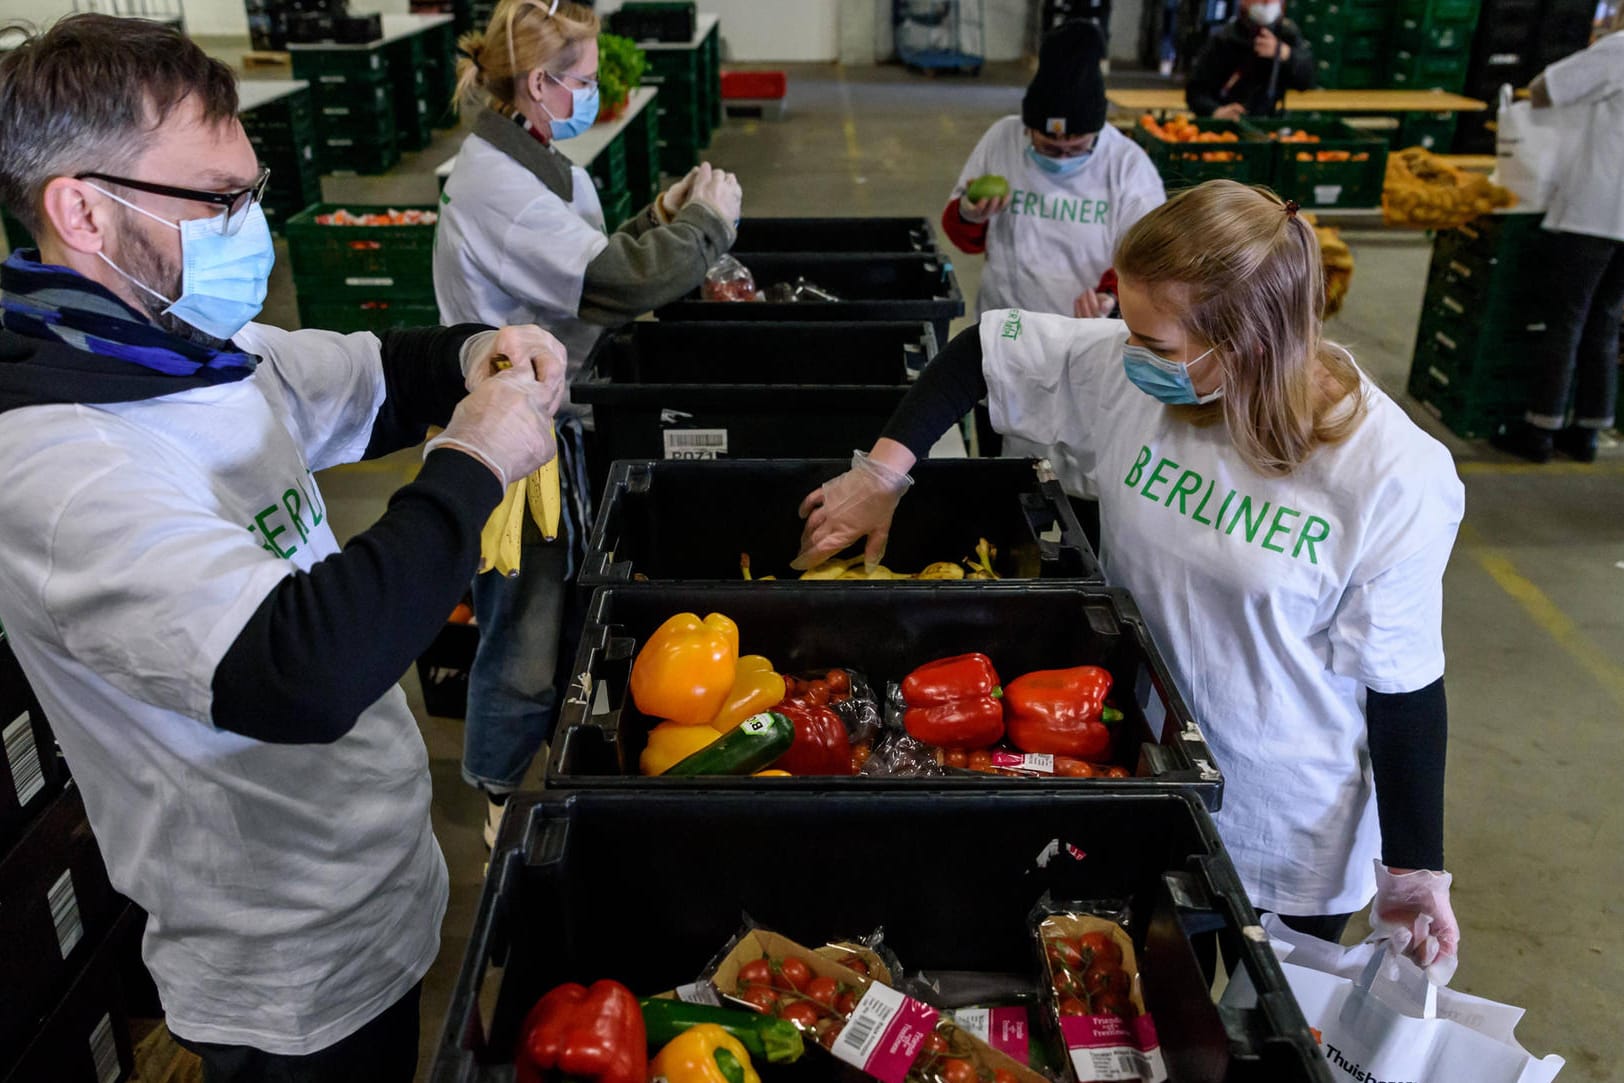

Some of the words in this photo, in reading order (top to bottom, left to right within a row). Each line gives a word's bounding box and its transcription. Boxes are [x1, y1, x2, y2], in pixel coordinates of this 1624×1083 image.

[1010, 189, 1109, 224] ERLINER
[1124, 445, 1330, 565] BERLINER
[1326, 1043, 1416, 1083] Thuisb
